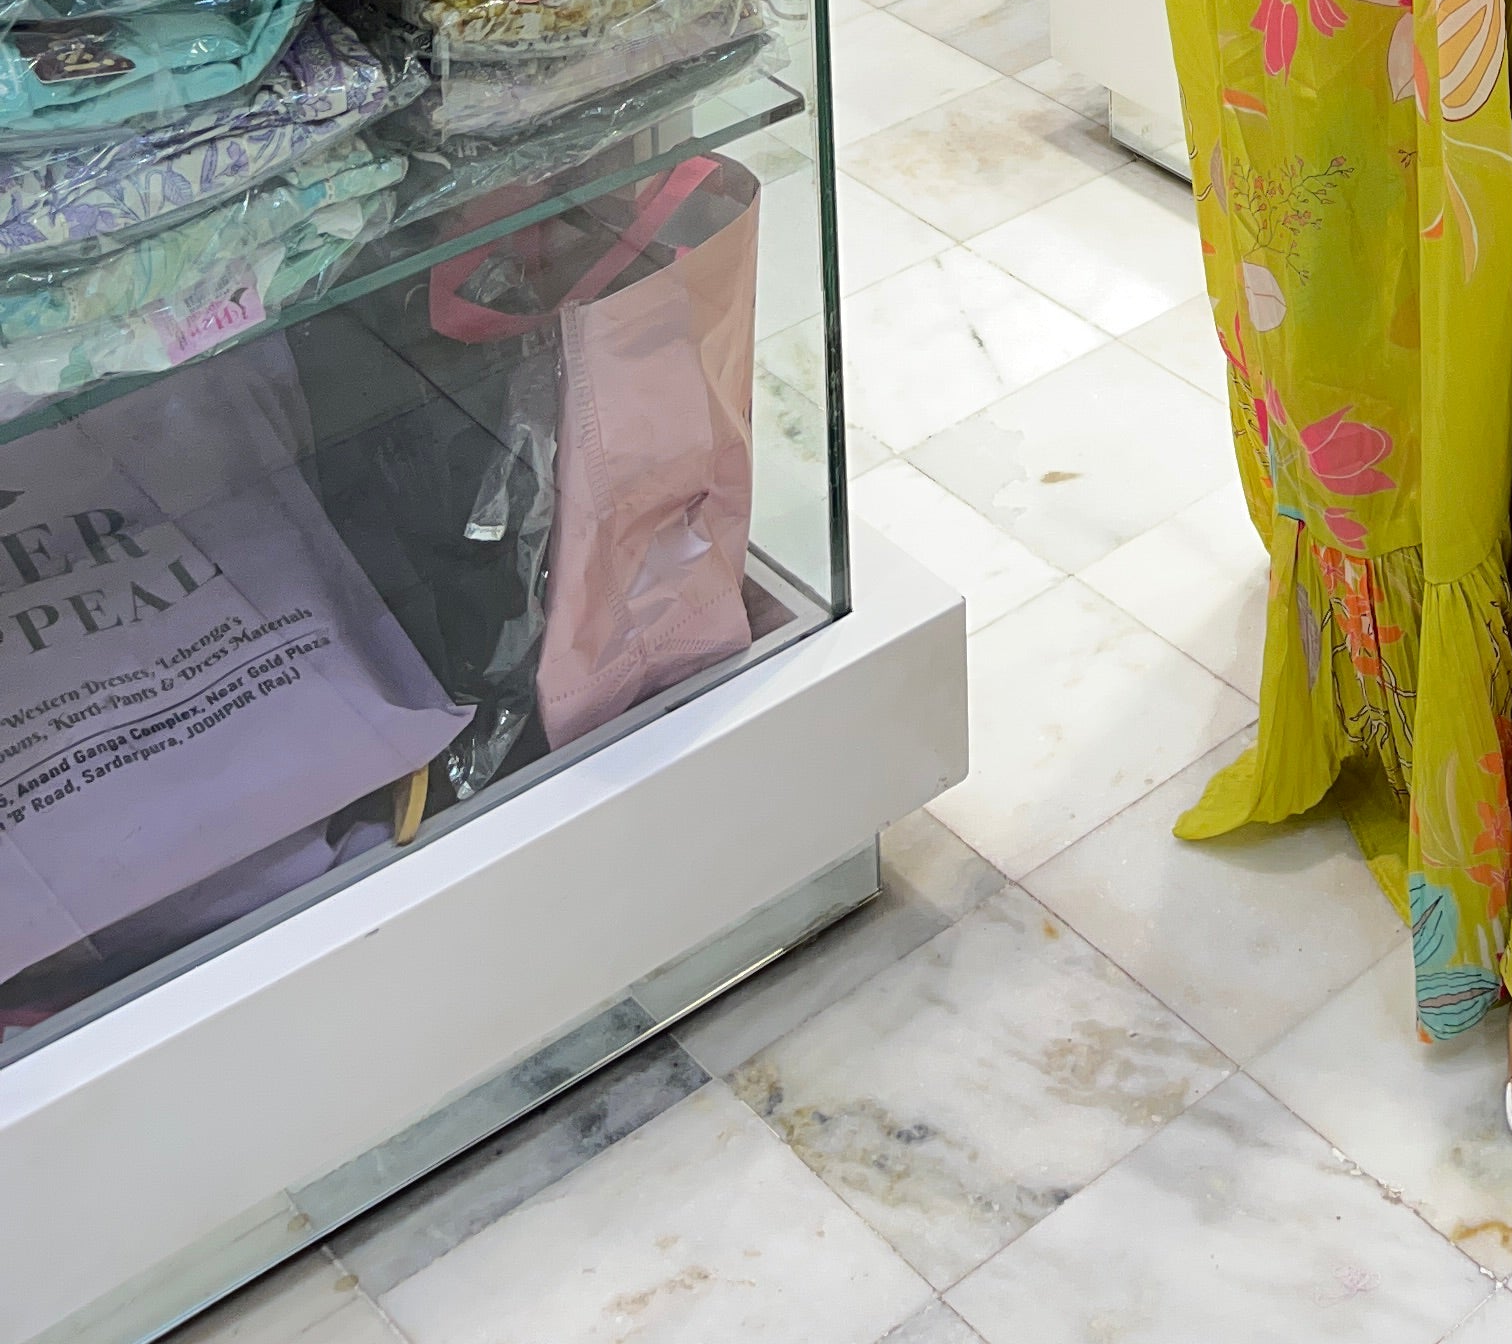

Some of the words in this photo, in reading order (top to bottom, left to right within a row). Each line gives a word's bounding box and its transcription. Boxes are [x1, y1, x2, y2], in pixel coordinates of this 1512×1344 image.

[0, 555, 223, 655] PEAL
[228, 608, 313, 651] Materials
[17, 757, 71, 798] Anand
[73, 735, 127, 764] Ganga
[129, 705, 206, 741] Complex,
[205, 676, 244, 705] Near
[247, 653, 284, 679] Gold
[284, 636, 331, 661] Plaza
[31, 778, 82, 812] Road,
[187, 690, 256, 739] JODHPUR
